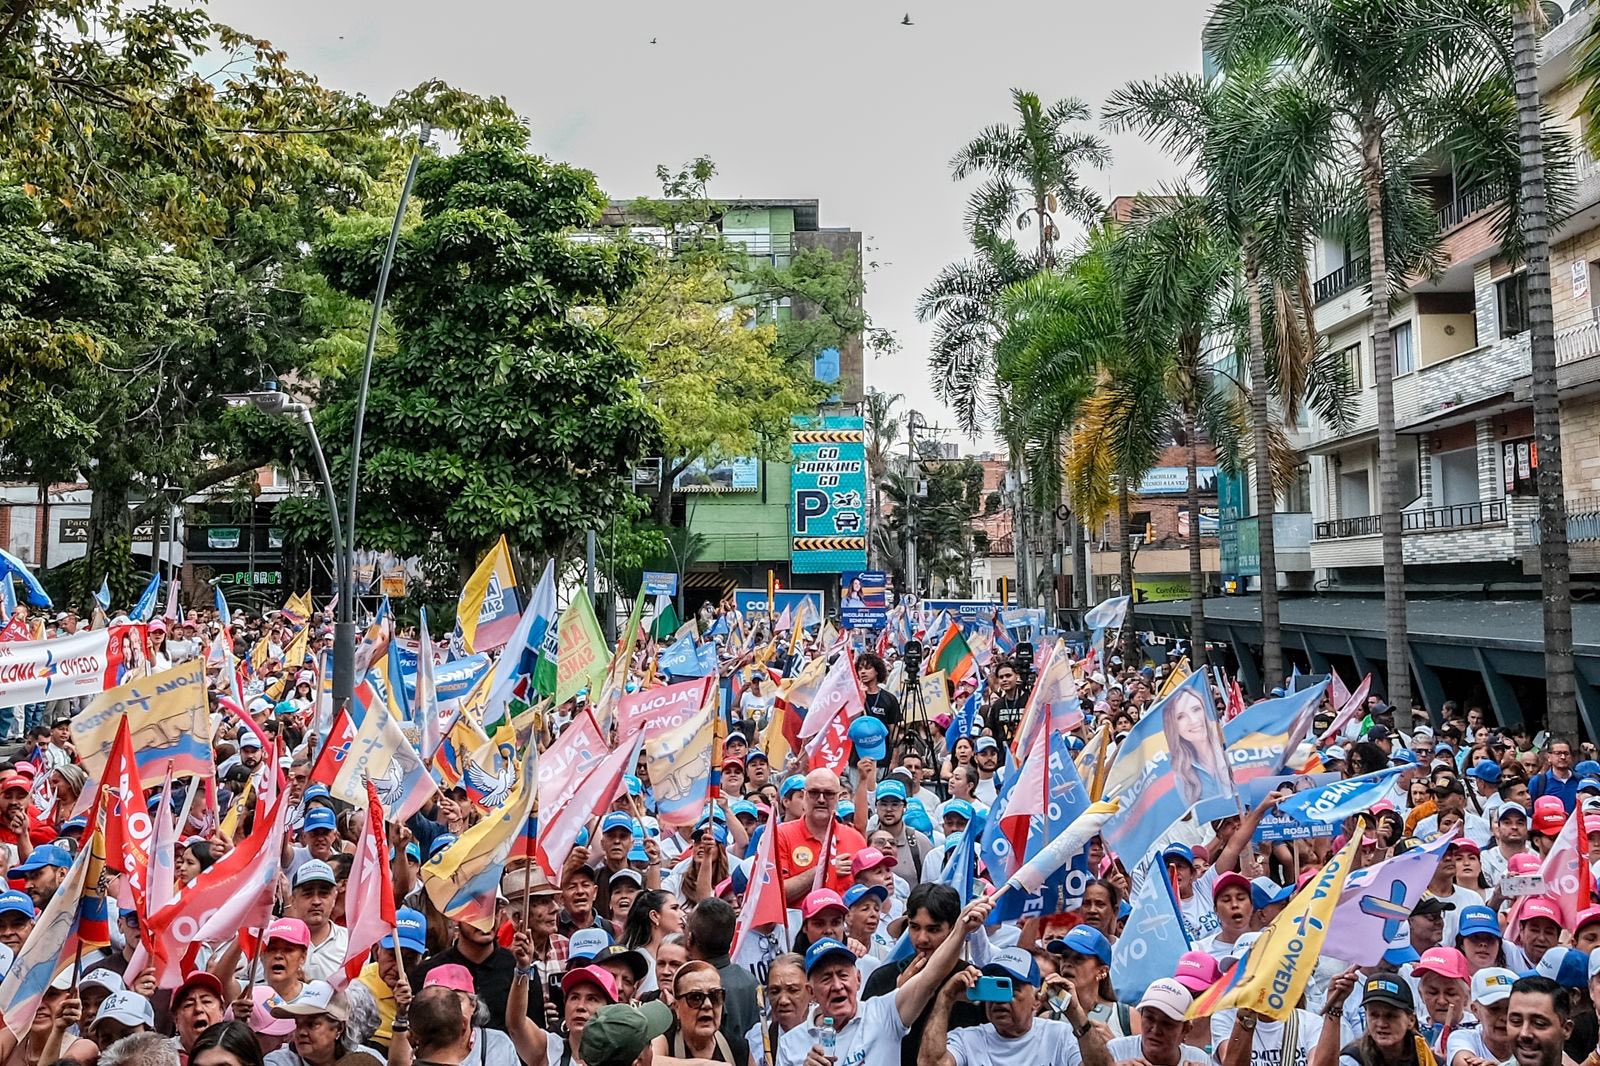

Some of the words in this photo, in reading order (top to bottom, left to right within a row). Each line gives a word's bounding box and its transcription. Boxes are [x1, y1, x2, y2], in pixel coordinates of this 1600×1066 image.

[818, 449, 839, 459] GO
[796, 461, 860, 474] PARKING
[818, 475, 839, 487] GO
[796, 490, 829, 533] P
[66, 520, 89, 531] Parq
[131, 527, 166, 536] MA
[0, 661, 37, 685] LOMA
[60, 656, 100, 677] OVIEDO
[957, 705, 972, 740] VIEDO
[1283, 827, 1310, 836] ROSA
[1311, 844, 1351, 900] LOMA
[1203, 922, 1220, 934] ED
[1267, 938, 1304, 1010] OVIEDO
[1250, 1049, 1283, 1062] OMIT
